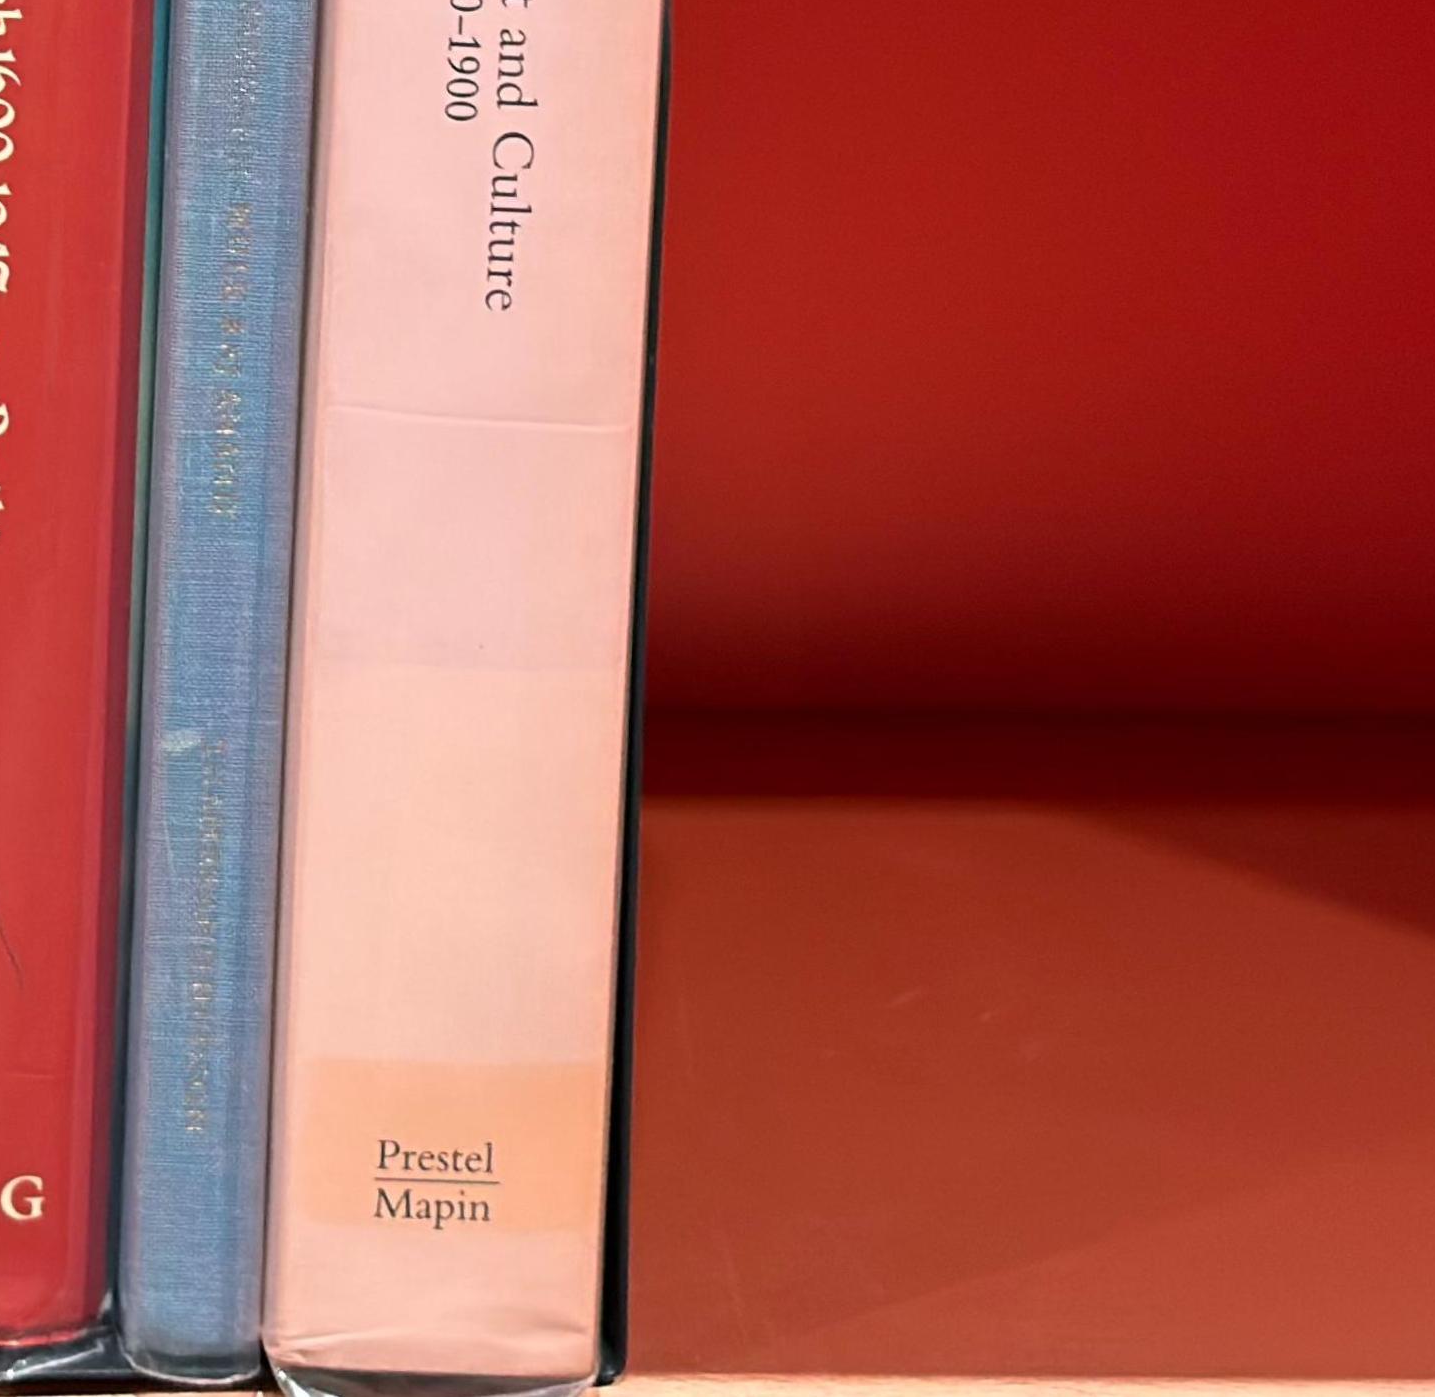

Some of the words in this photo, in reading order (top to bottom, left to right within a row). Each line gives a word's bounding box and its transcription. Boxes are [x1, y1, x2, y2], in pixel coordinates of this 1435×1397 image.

[495, 27, 539, 110] and
[483, 131, 536, 313] Culture
[376, 1138, 495, 1174] Prestel
[373, 1186, 492, 1230] Mapin
